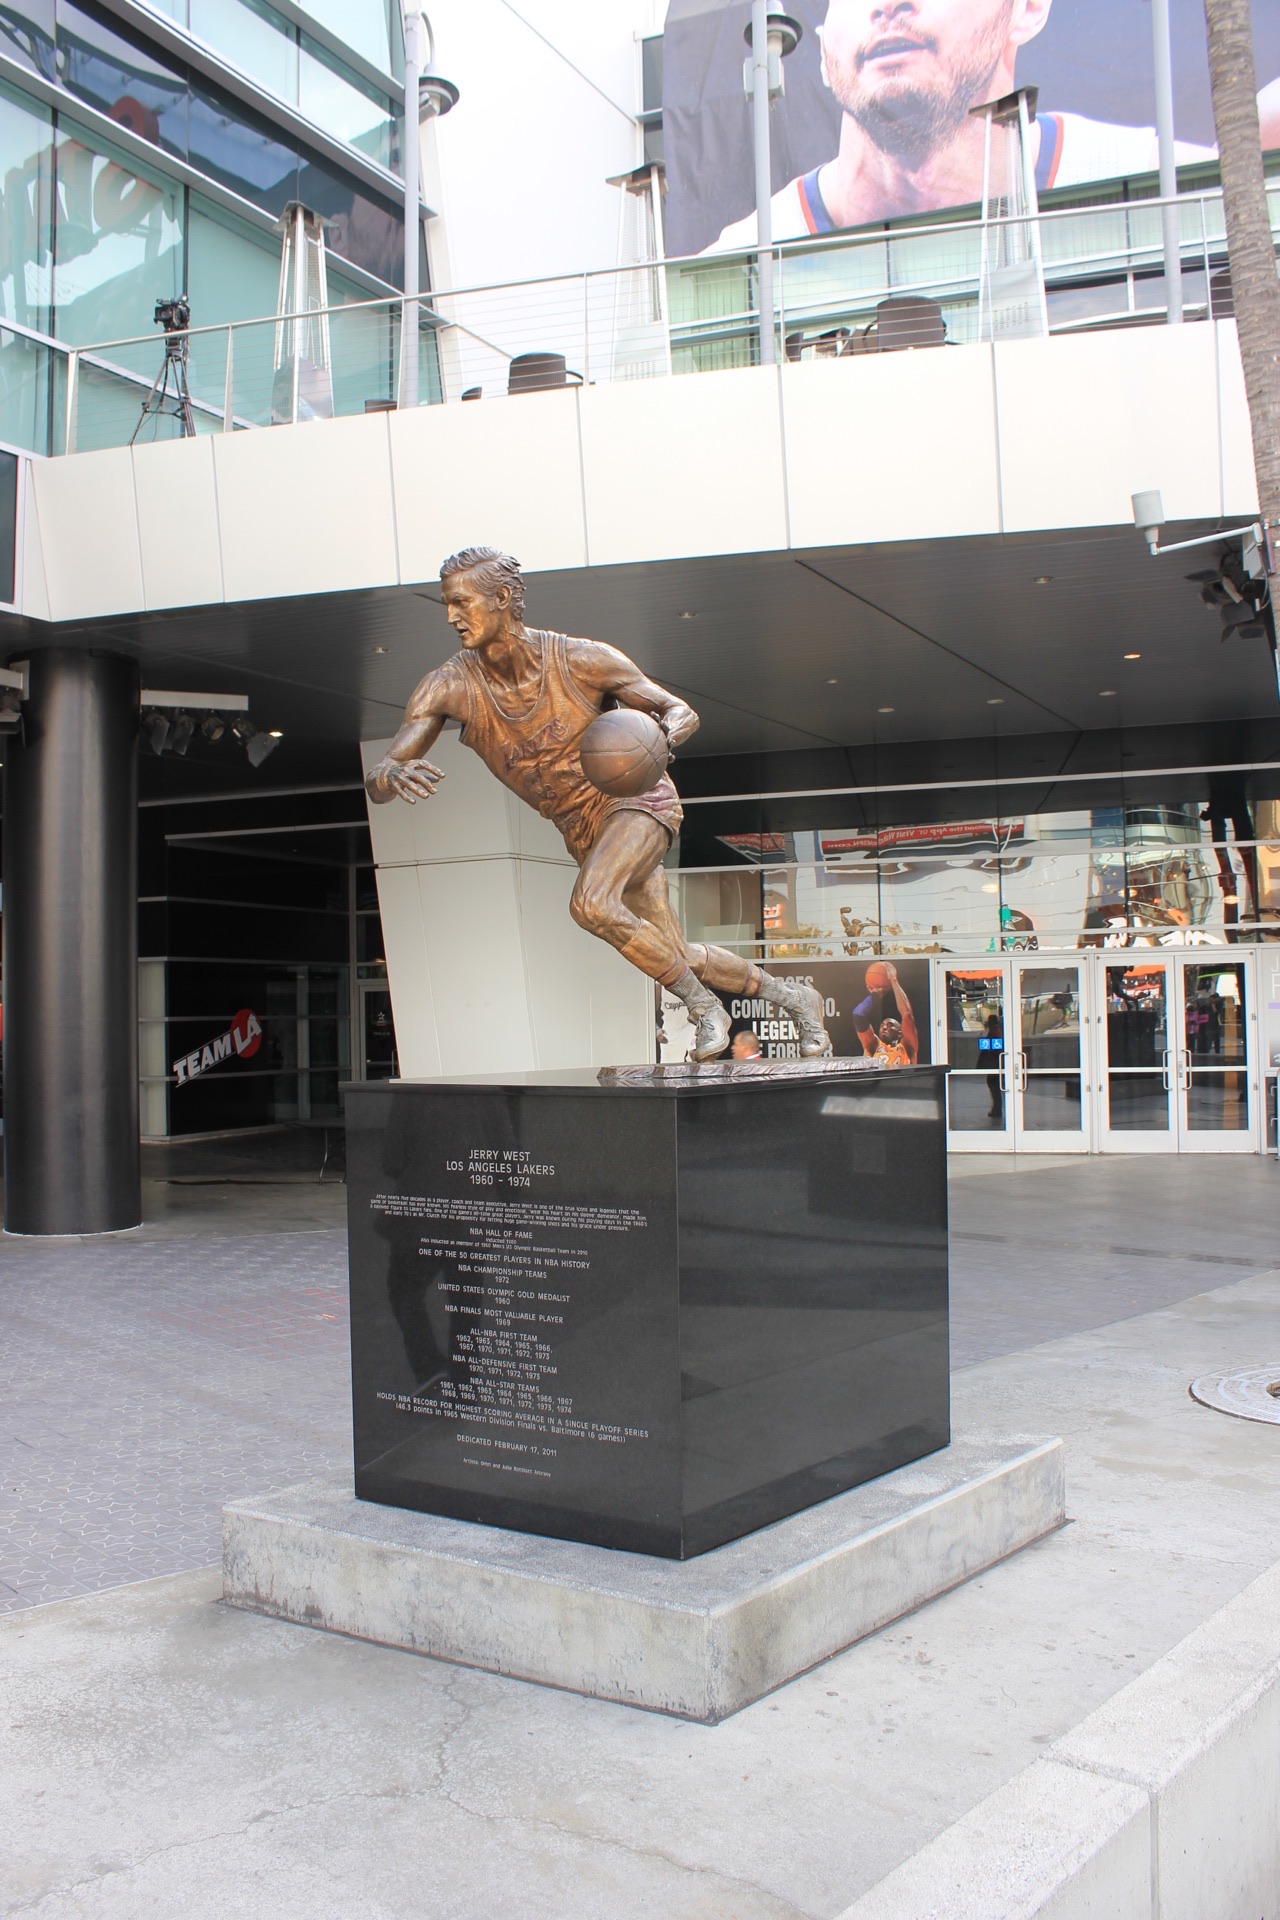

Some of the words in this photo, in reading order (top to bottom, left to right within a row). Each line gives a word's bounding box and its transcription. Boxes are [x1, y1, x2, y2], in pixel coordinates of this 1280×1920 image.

[731, 999, 774, 1018] COME
[173, 1033, 233, 1085] TEAM
[233, 1013, 262, 1055] LA
[468, 1149, 499, 1160] JERRY
[502, 1150, 530, 1162] WEST
[446, 1160, 463, 1171] LOS
[467, 1161, 511, 1174] ANGELES
[517, 1163, 555, 1175] LAKERS
[469, 1173, 493, 1185] 1960
[507, 1175, 530, 1187] 1974
[469, 1227, 483, 1235] NBA
[485, 1228, 501, 1237] HALL
[503, 1230, 512, 1238] OF
[514, 1230, 532, 1239] FAME
[418, 1247, 431, 1256] ONE
[434, 1248, 442, 1257] OF
[444, 1249, 456, 1258] THE
[459, 1251, 467, 1259] 50
[469, 1252, 501, 1262] GREATEST
[503, 1255, 531, 1264] PLAYERS
[534, 1257, 541, 1265] IN
[544, 1258, 558, 1266] NBA
[561, 1259, 590, 1269] HISTORY
[457, 1263, 471, 1272] NBA
[473, 1265, 522, 1277] CHAMPIONSHIP
[524, 1269, 547, 1279] TEAMS
[437, 1282, 460, 1292] UNITED
[462, 1284, 484, 1294] STATES
[487, 1287, 514, 1297] OLYMPIC
[517, 1290, 534, 1299] GOLD
[537, 1292, 570, 1302] MEDALIST
[444, 1304, 458, 1312] NBA
[460, 1305, 481, 1315] FINALS
[483, 1308, 502, 1317] MOST
[504, 1310, 536, 1321] VALUABLE
[538, 1313, 563, 1324] PLAYER
[469, 1327, 497, 1338] ALL-NBA
[499, 1330, 517, 1339] FIRST
[519, 1333, 537, 1342] TEAM
[452, 1353, 466, 1362] NBA
[467, 1355, 516, 1369] ALL-DEFENSIVE
[519, 1362, 536, 1371] FIRST
[539, 1364, 557, 1374] TEAM
[469, 1376, 483, 1385] NBA
[485, 1378, 514, 1390] ALL-STAR
[517, 1383, 539, 1393] TEAMS
[376, 1391, 396, 1401] HOLDS
[398, 1394, 410, 1403] NBA
[413, 1396, 437, 1407] RECORD
[440, 1400, 452, 1409] FOR
[455, 1403, 481, 1414] HIGHEST
[483, 1407, 512, 1418] SCORING
[514, 1411, 544, 1423] AVERAGE
[547, 1416, 554, 1424] IN
[565, 1419, 588, 1429] SINGLE
[591, 1422, 621, 1434] PLAYOFF
[624, 1427, 648, 1438] SERIES
[413, 1405, 433, 1415] points
[443, 1409, 458, 1418] 1965
[460, 1412, 486, 1423] Western
[489, 1416, 514, 1427] Division
[517, 1420, 536, 1430] Finals
[538, 1424, 547, 1432] vs.
[551, 1425, 585, 1437] Baltimore
[456, 1433, 491, 1446] DEDICATED
[494, 1439, 527, 1452] FEBRUARY
[530, 1445, 539, 1455] 17,
